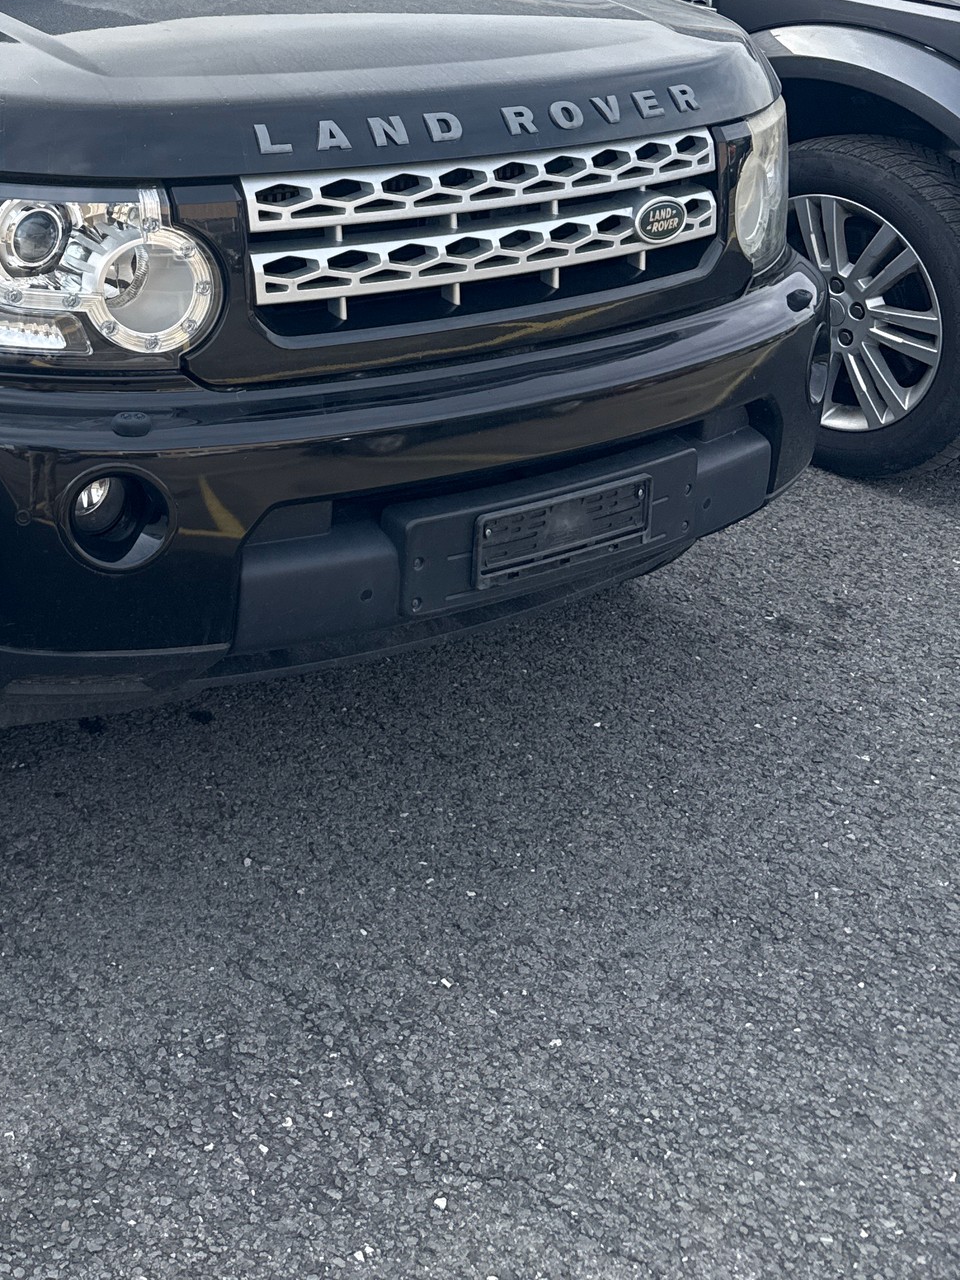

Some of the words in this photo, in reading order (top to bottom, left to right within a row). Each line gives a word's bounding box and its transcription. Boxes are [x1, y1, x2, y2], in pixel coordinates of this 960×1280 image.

[253, 111, 463, 154] LAND
[500, 83, 702, 136] ROVER
[649, 207, 672, 222] LAND
[651, 217, 679, 233] ROVER
